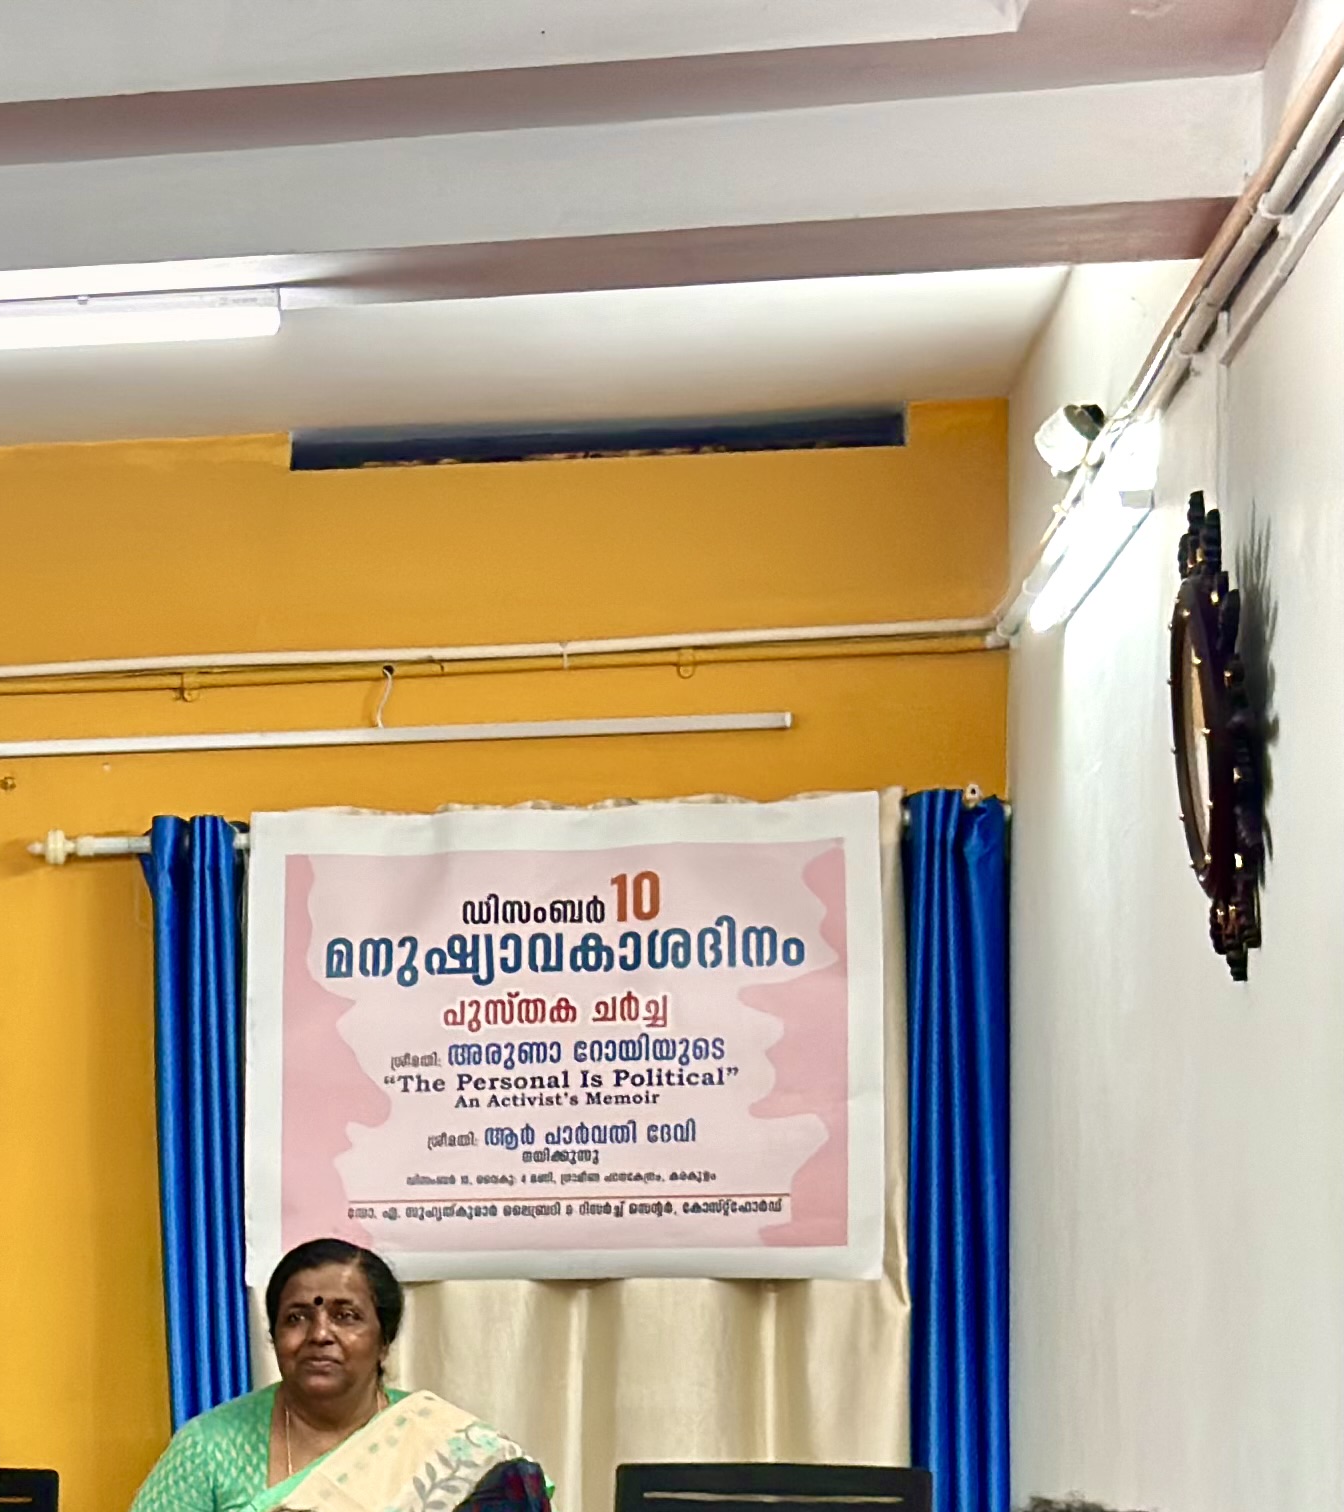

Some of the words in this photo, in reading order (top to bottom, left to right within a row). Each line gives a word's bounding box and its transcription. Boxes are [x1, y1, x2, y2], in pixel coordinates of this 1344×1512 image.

[462, 893, 606, 925] ഡിസംബർ
[610, 870, 661, 922] 10
[325, 915, 806, 987] മനുഷ്യാവകാശദിനം
[443, 991, 578, 1033] പുസ്തക
[592, 991, 669, 1028] ചർച്ച
[448, 1041, 562, 1070] അരുണാ
[573, 1033, 725, 1066] റോയിയുടെ
[454, 1094, 480, 1108] An
[586, 1090, 660, 1106] Memoir
[456, 1070, 570, 1091] Personal
[580, 1070, 603, 1088] Is
[484, 1123, 535, 1150] ആർ
[544, 1119, 637, 1145] പാർവതി
[646, 1117, 697, 1143] ദേവി
